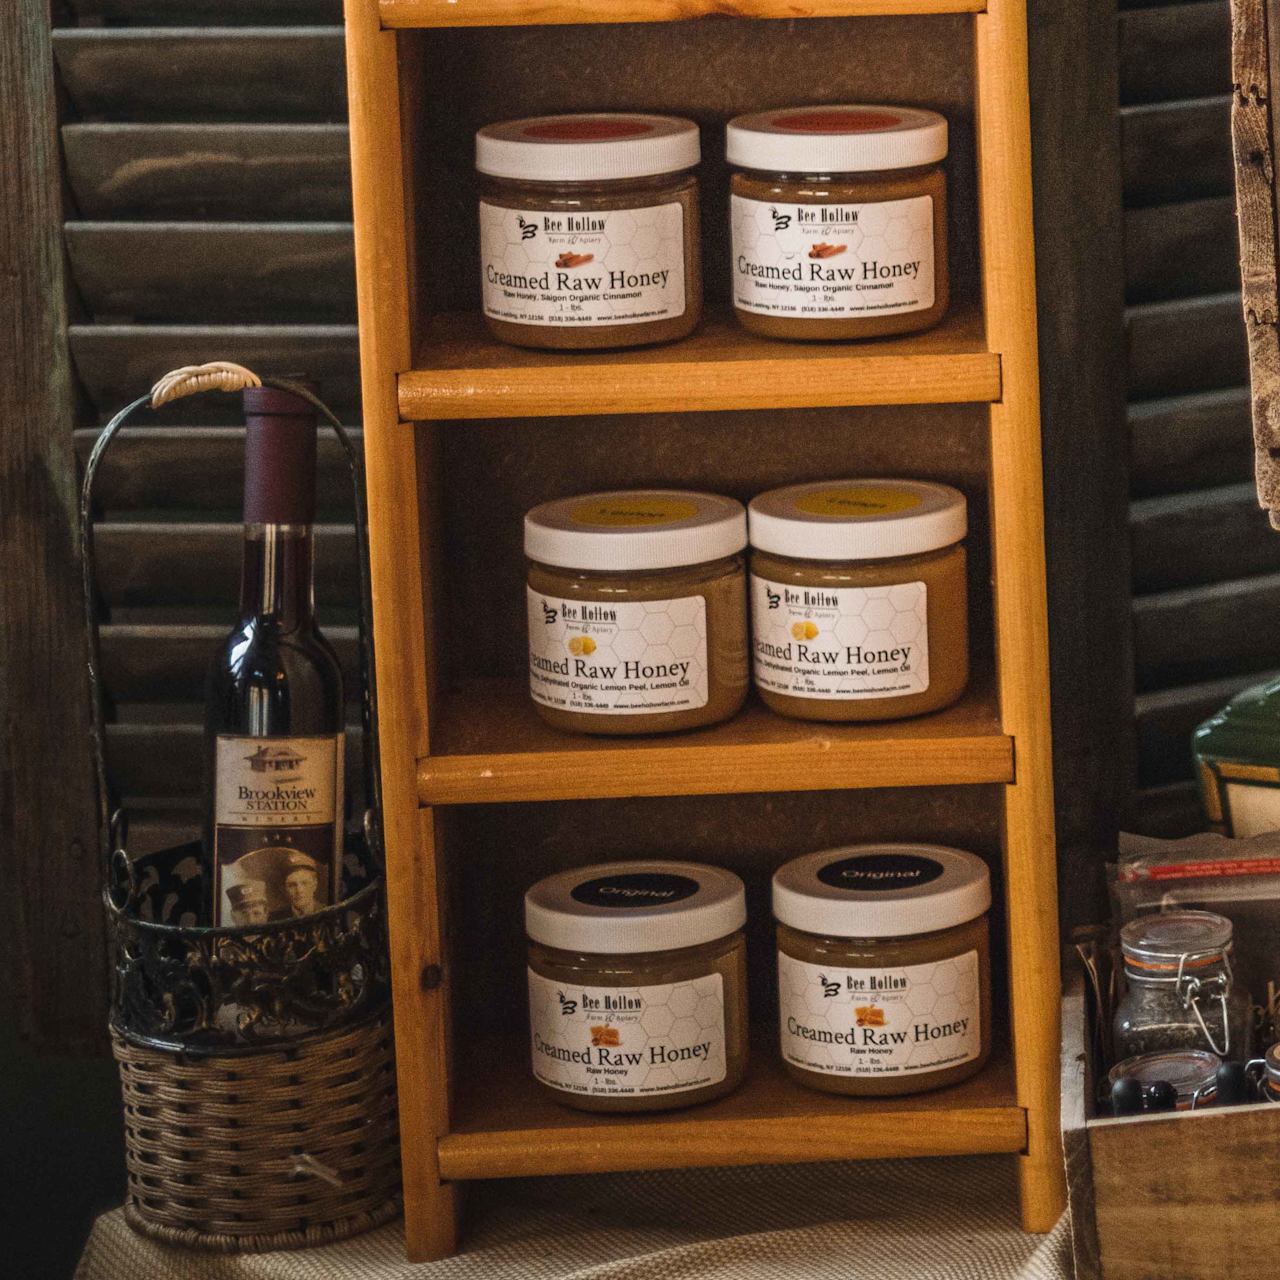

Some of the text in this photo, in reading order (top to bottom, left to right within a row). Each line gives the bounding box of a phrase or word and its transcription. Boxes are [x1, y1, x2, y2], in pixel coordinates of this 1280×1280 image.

[798, 208, 859, 222] Bee Hollow
[544, 216, 605, 232] Bee Hollow
[487, 264, 670, 290] Creamed Raw Honey
[738, 256, 921, 281] Creamed Raw Honey
[785, 589, 839, 607] Bee Hollow
[562, 604, 617, 621] Bee Hollow
[798, 644, 911, 666] Raw Honey
[531, 654, 690, 682] reamed Raw Honey
[238, 786, 316, 800] Brookview
[246, 800, 308, 810] STATION
[841, 868, 922, 880] Original
[847, 976, 907, 990] Bee Hollow
[582, 994, 642, 1010] Bee Hollow
[787, 1017, 969, 1046] Creamed Raw Honey
[534, 1032, 711, 1066] Creamed Raw Honey
